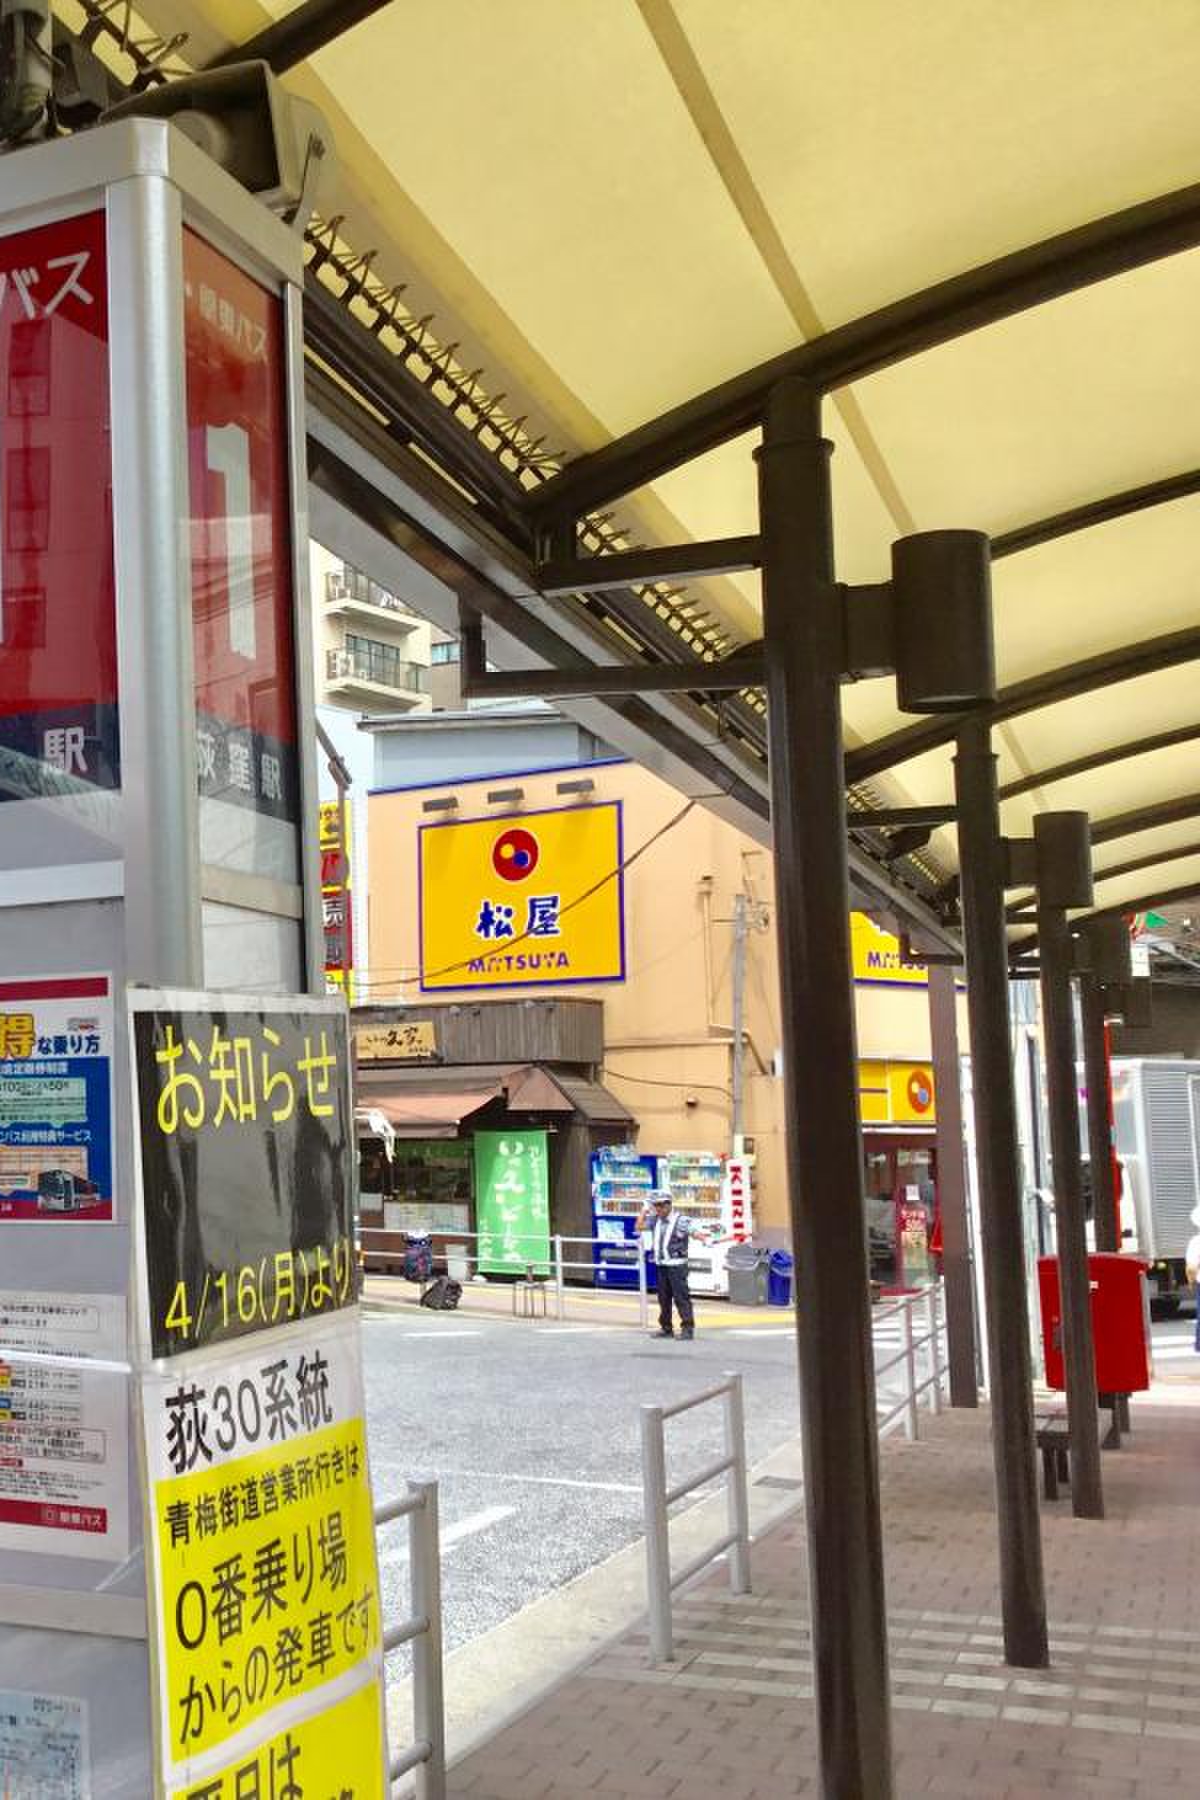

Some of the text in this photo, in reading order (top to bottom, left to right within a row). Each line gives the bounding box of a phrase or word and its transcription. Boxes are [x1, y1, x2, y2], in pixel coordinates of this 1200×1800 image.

[207, 422, 257, 661] 1
[467, 950, 570, 974] MATSUYA
[475, 894, 561, 939] 松屋
[155, 1024, 337, 1134] お知らせ
[164, 1237, 351, 1339] 4/16(月)より
[164, 1349, 334, 1474] 荻30系統
[163, 1442, 363, 1548] 青梅街道営業所行きは
